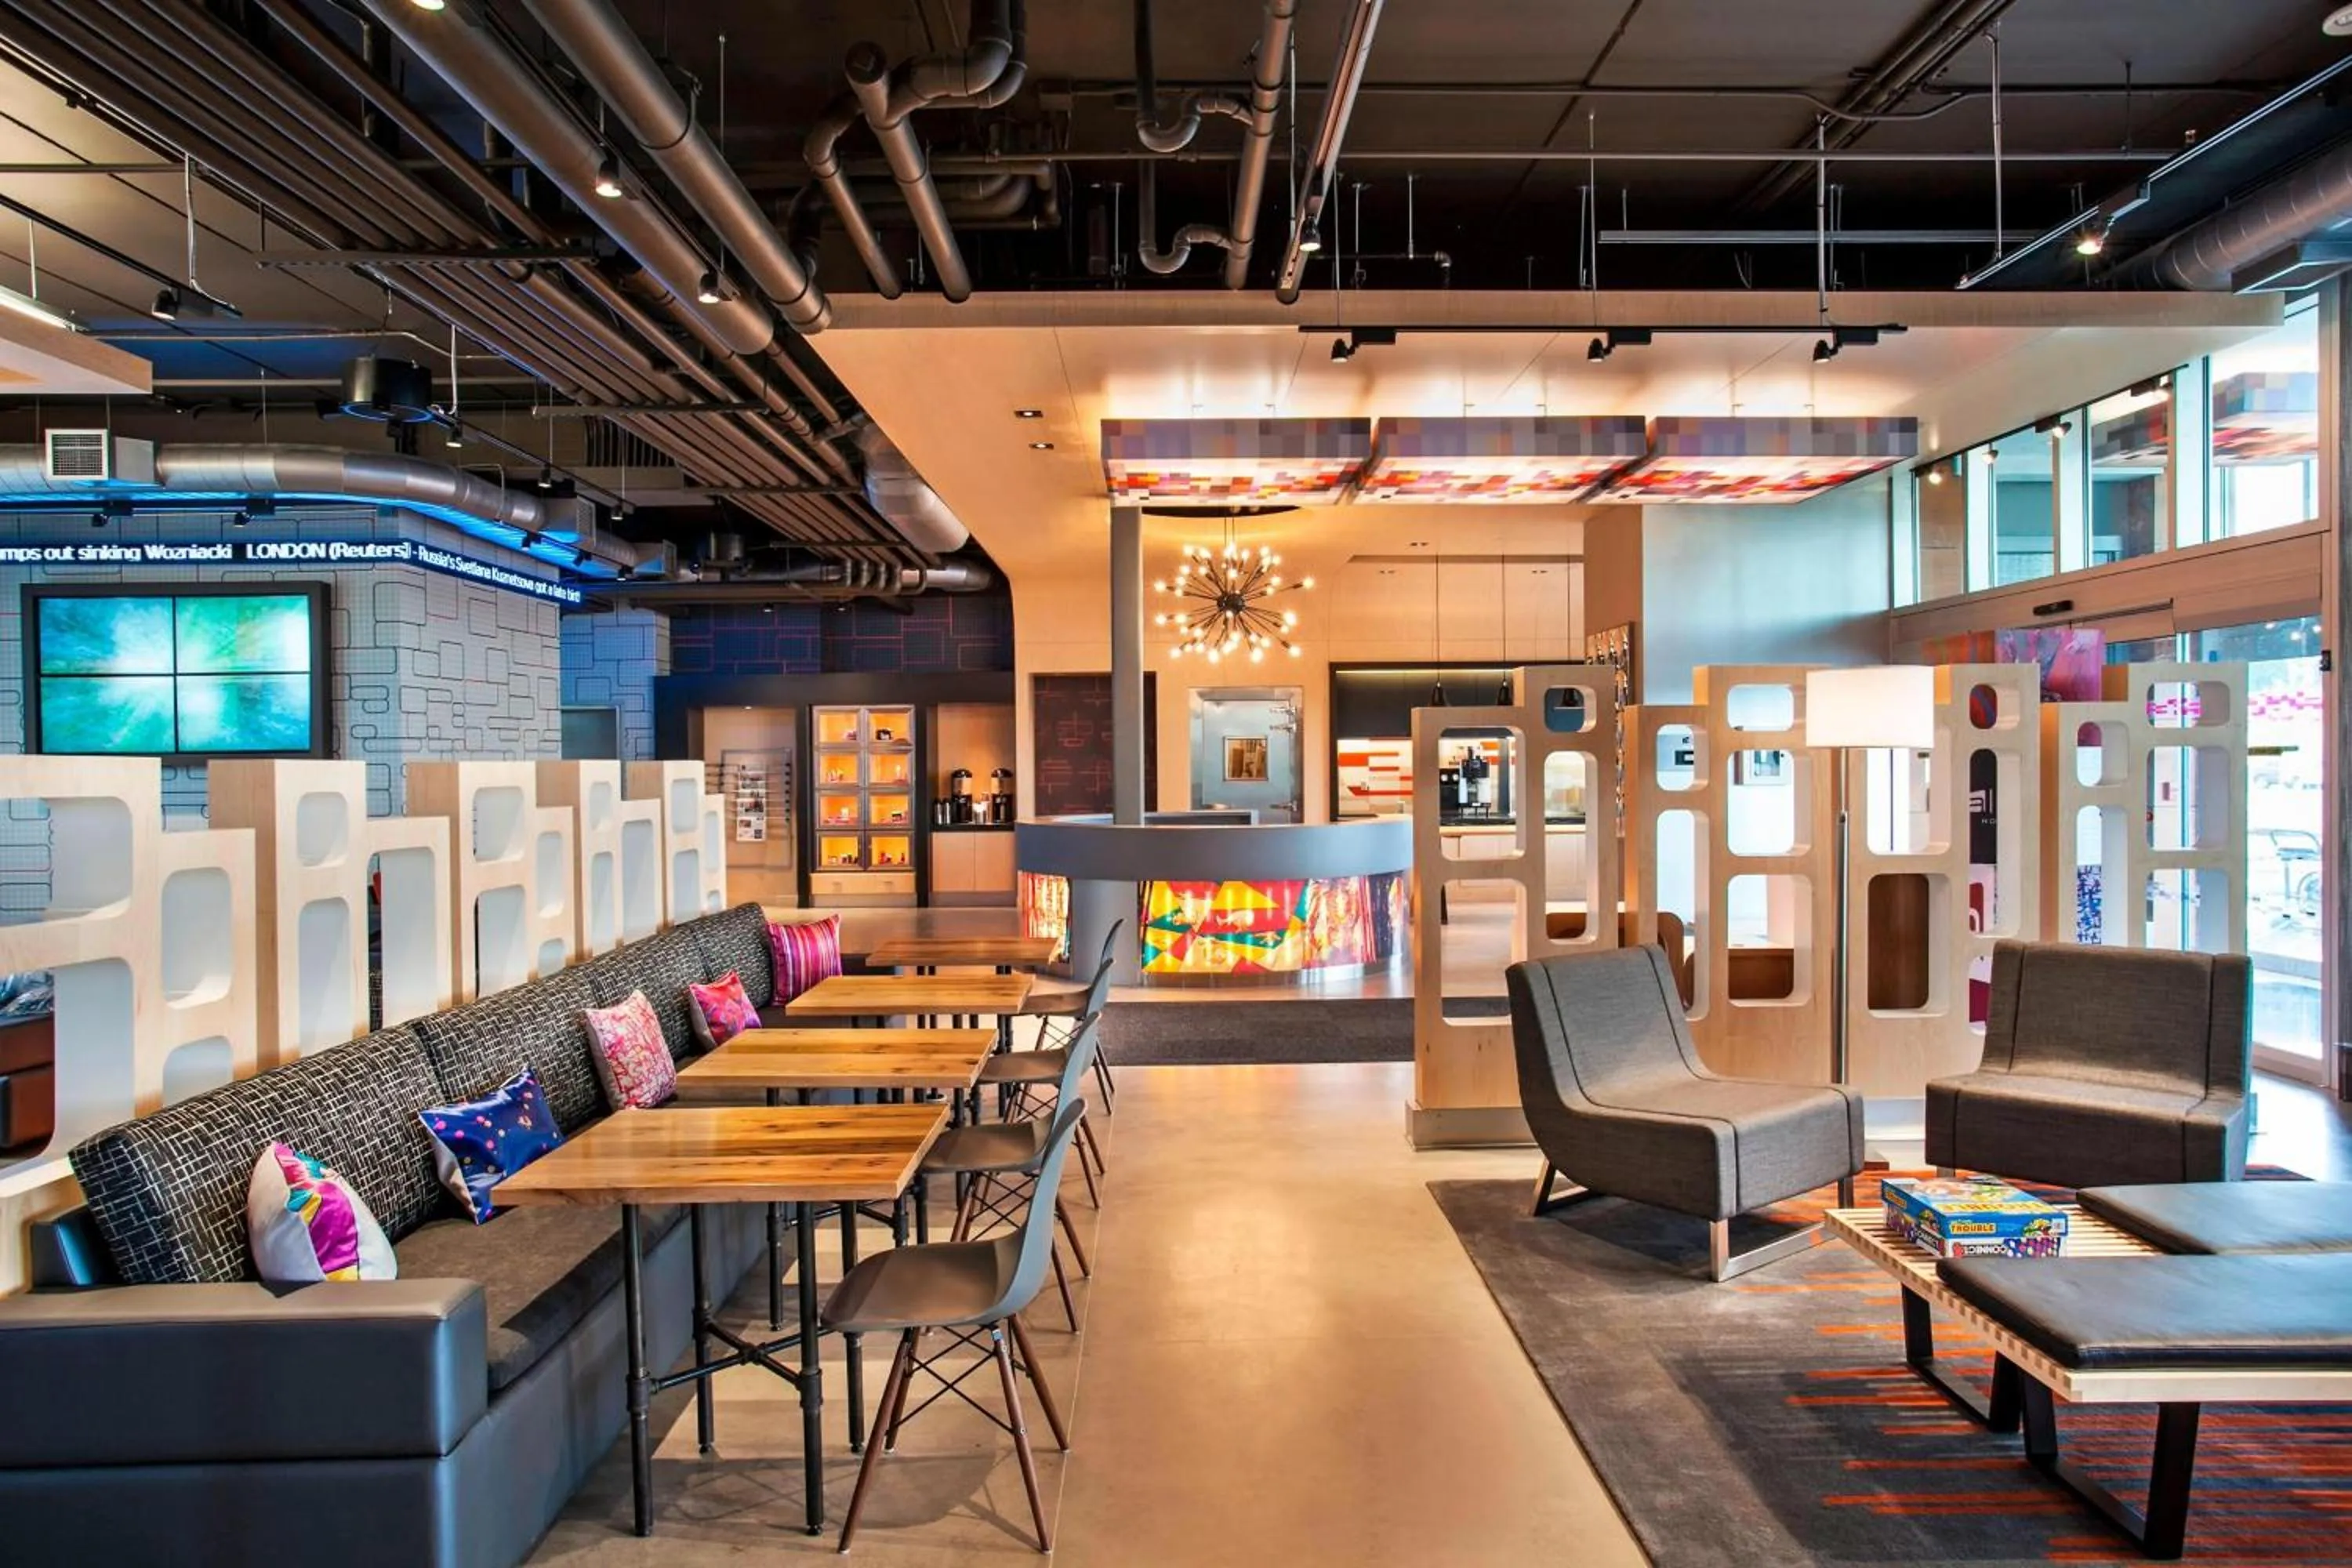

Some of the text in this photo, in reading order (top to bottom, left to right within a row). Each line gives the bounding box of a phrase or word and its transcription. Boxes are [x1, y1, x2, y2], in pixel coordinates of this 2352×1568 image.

[44, 546, 76, 561] out
[78, 545, 141, 562] sinking
[143, 544, 233, 560] Wozniacki
[246, 543, 326, 559] LONDON
[1951, 1223, 1995, 1232] TROUBLE
